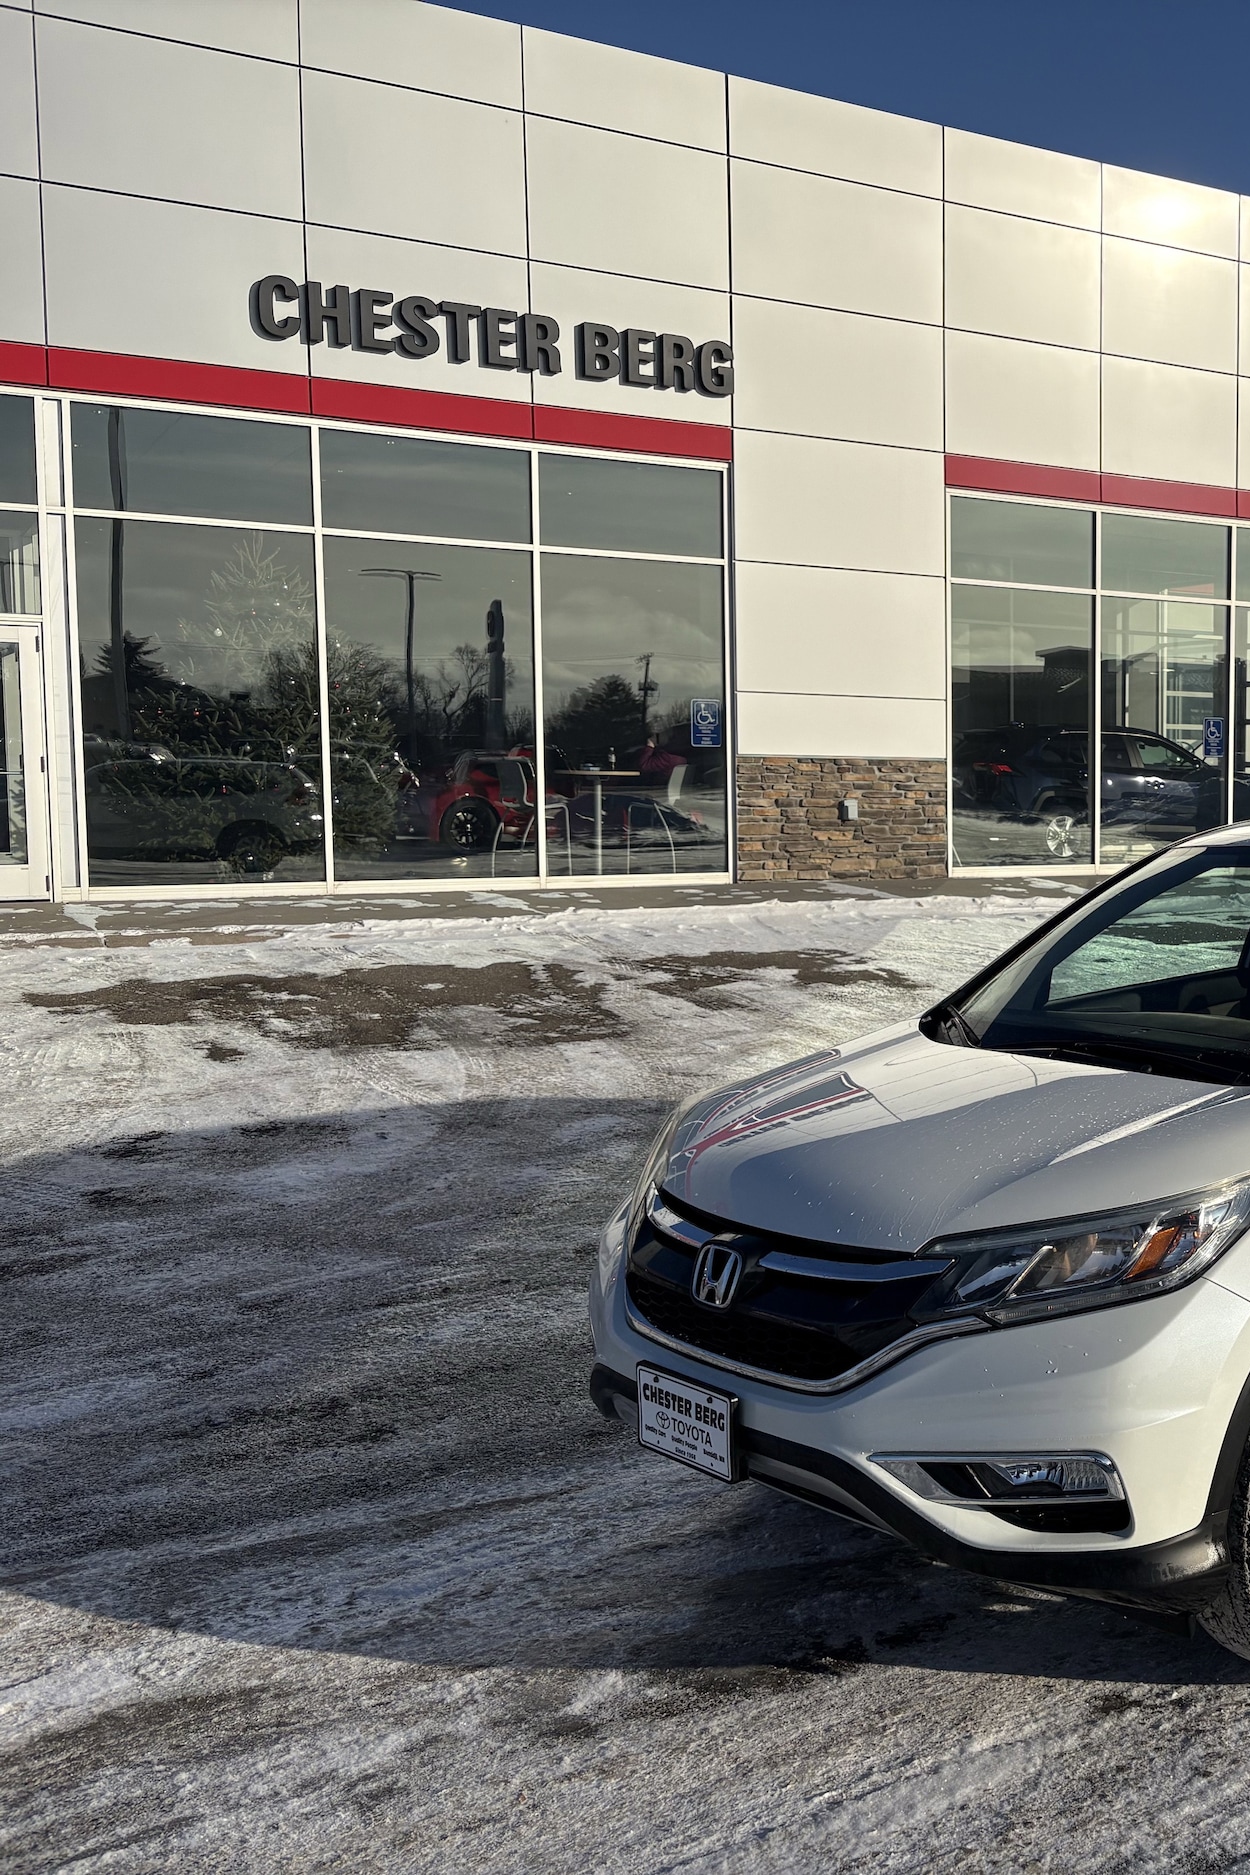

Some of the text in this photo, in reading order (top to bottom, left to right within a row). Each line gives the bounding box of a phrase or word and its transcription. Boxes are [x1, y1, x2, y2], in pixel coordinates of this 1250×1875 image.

[249, 275, 735, 398] CHESTER BERG
[643, 1383, 725, 1431] CHESTER BERG
[671, 1417, 712, 1447] TOYOTA
